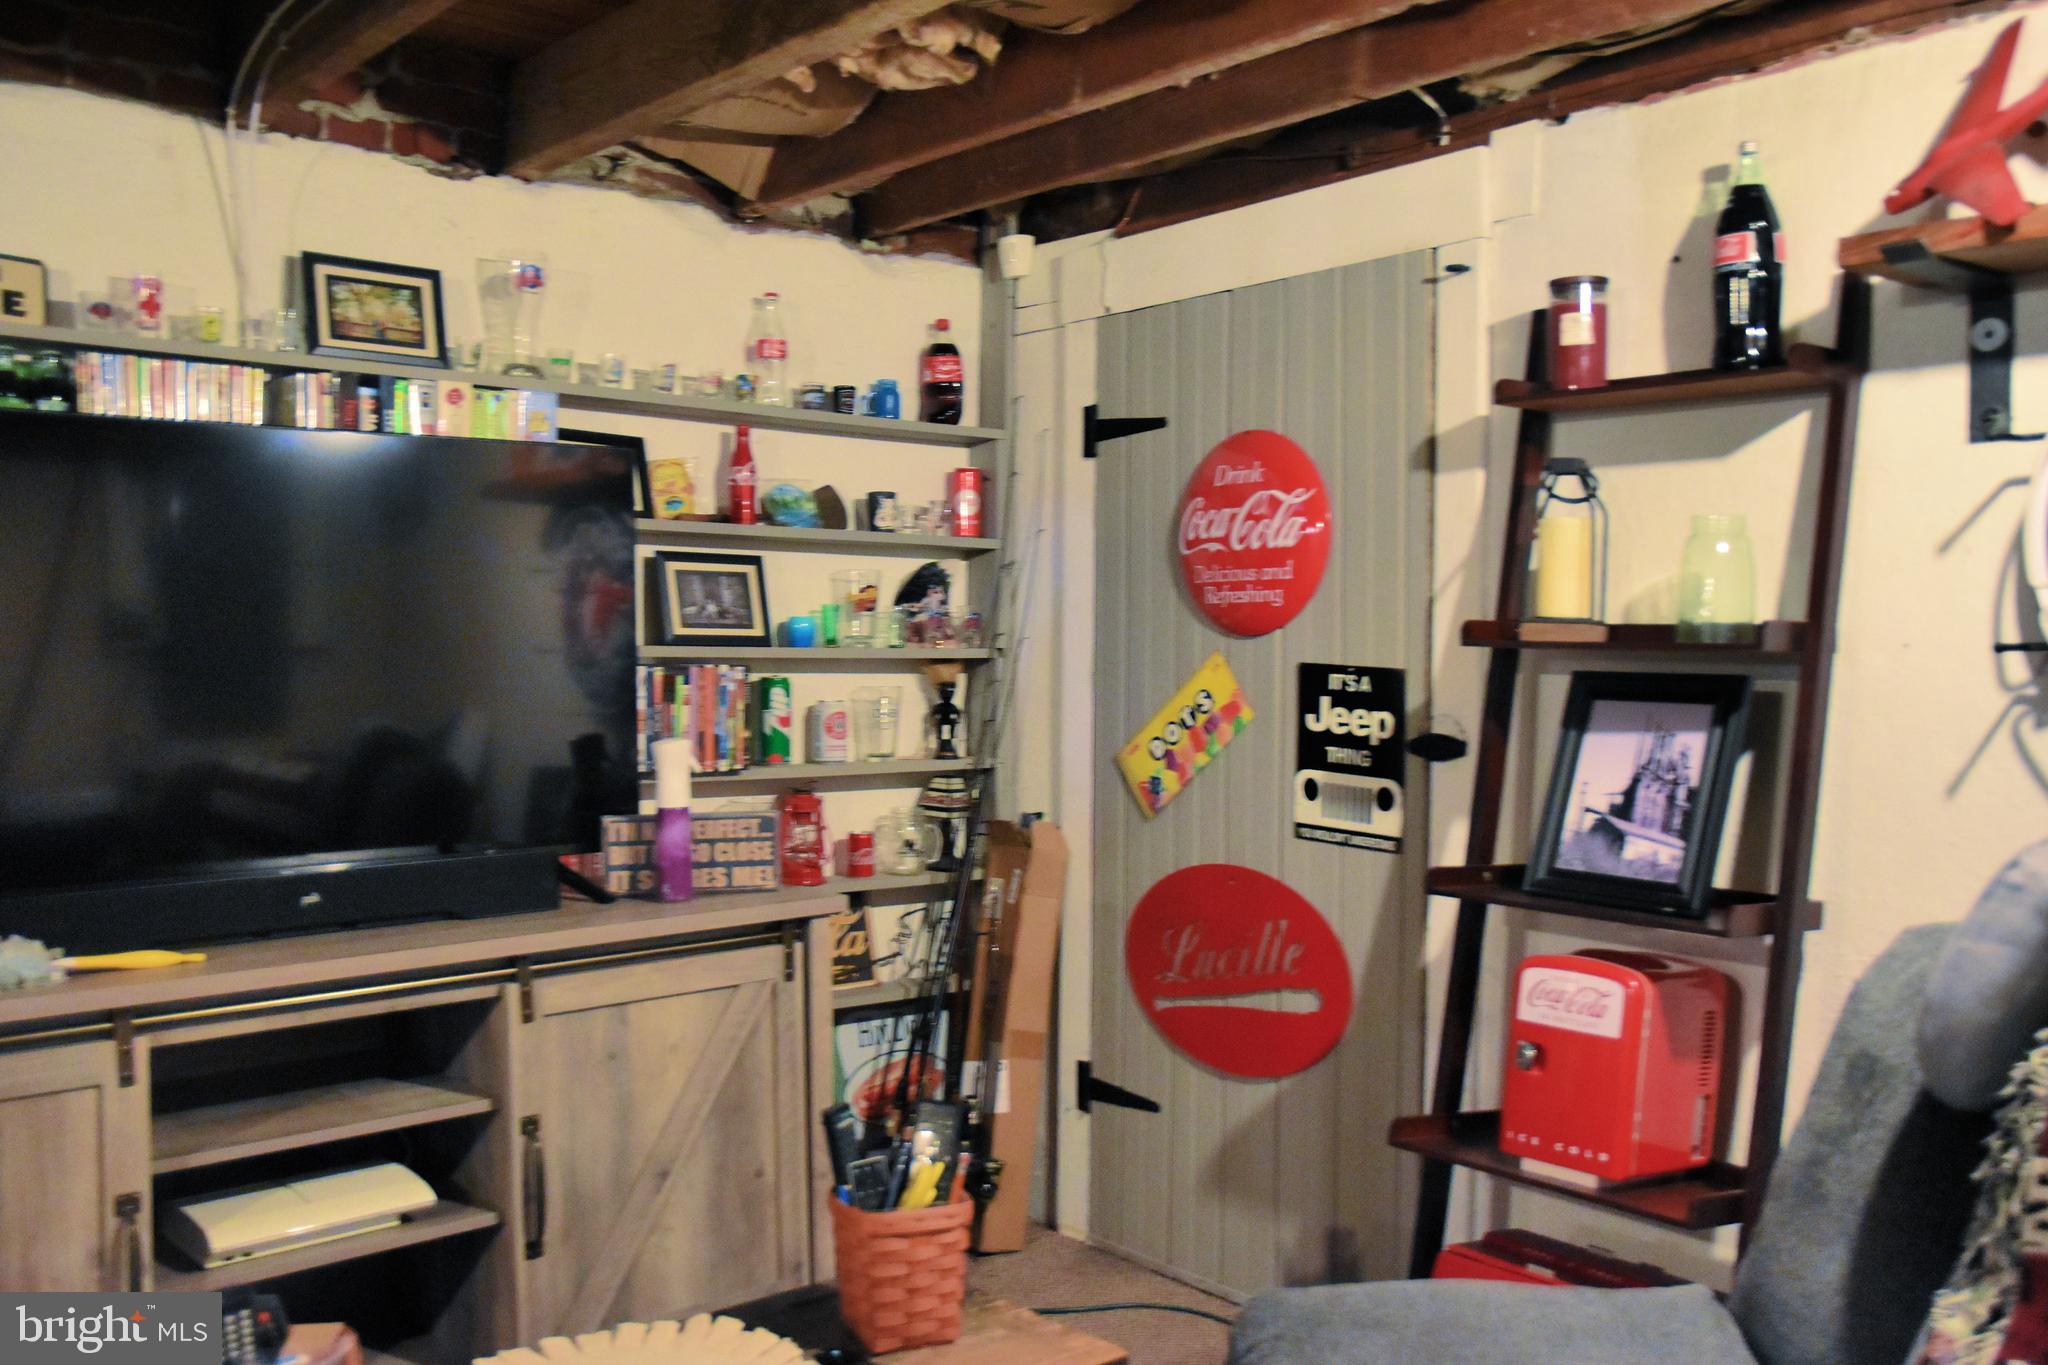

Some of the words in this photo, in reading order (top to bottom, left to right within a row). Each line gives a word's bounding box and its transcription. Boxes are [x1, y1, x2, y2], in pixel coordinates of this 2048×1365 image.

[1261, 560, 1294, 580] and
[1304, 695, 1397, 746] Jeep
[1155, 919, 1305, 983] Lucille
[1553, 1142, 1610, 1162] COLD
